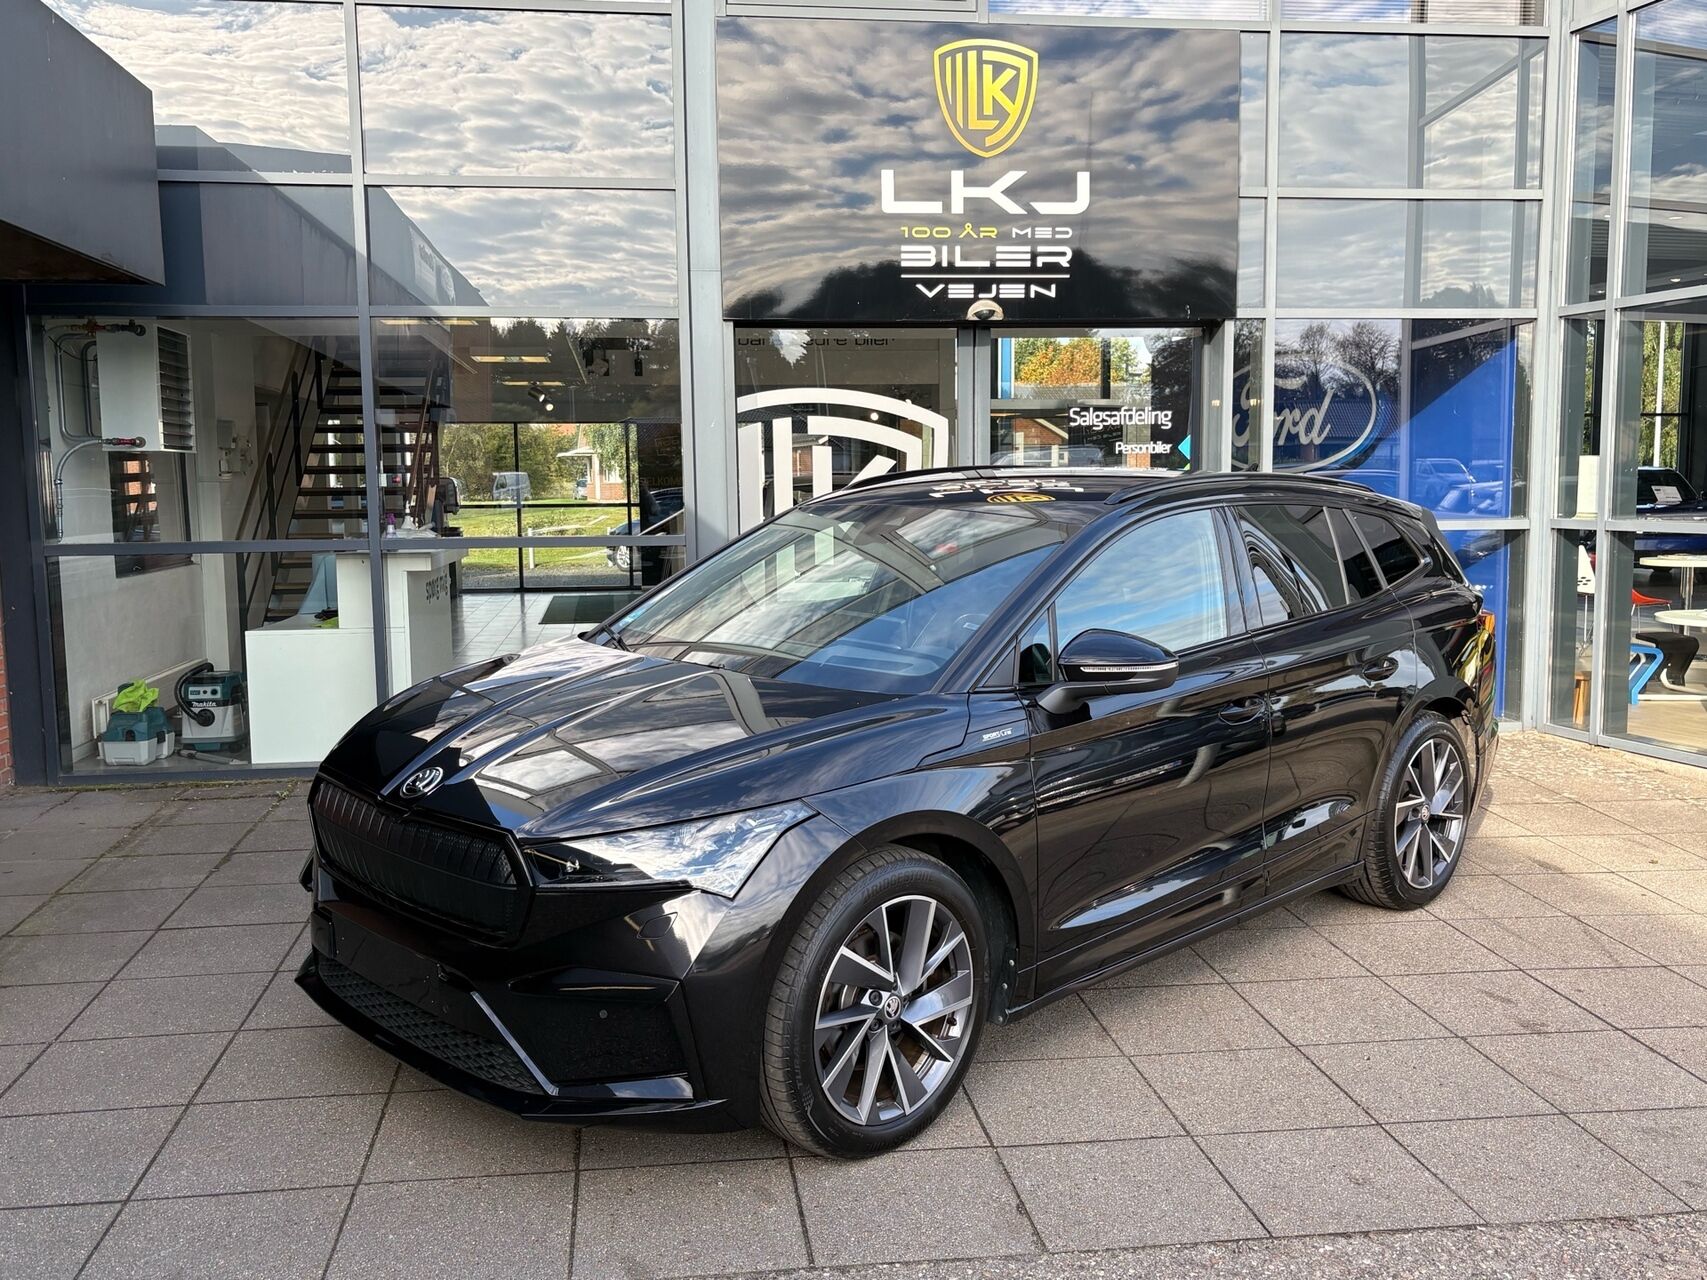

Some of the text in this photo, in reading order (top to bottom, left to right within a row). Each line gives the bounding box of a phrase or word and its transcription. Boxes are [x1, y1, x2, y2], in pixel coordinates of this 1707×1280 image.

[881, 169, 1091, 215] LKJ
[900, 222, 1073, 239] 100 ÅR MED
[900, 245, 1074, 268] BILER
[915, 284, 1057, 299] VEJEN
[1069, 406, 1173, 430] Salgsafdeling
[1115, 441, 1173, 455] Personbiler
